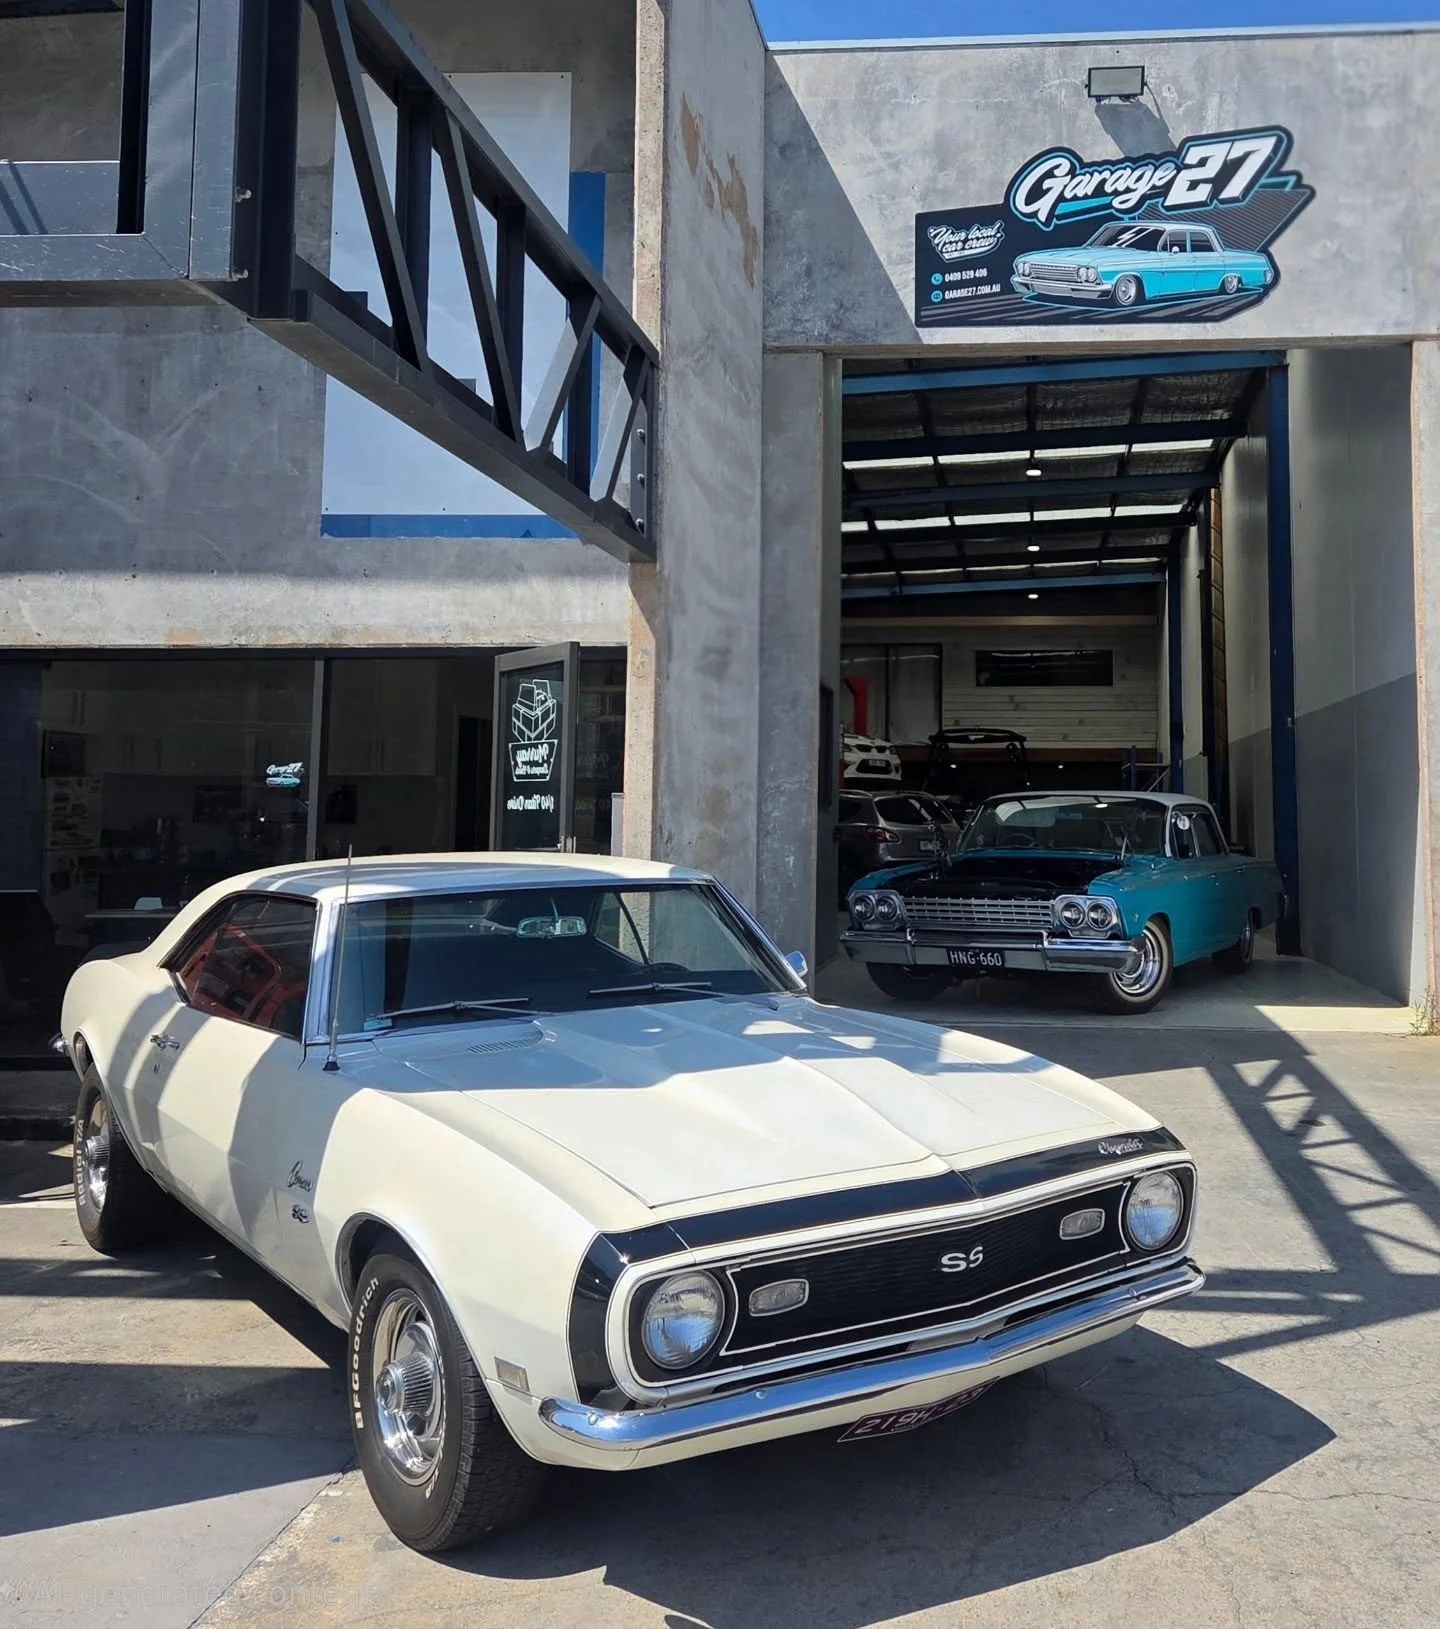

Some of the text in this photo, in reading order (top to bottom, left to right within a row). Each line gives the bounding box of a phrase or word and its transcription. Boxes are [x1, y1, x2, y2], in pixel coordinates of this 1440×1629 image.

[1014, 136, 1278, 223] Garage 27
[930, 222, 1000, 251] Your local
[942, 236, 998, 253] car crew
[944, 283, 1001, 300] GARAGE27.COM.AU
[941, 1246, 983, 1272] SS
